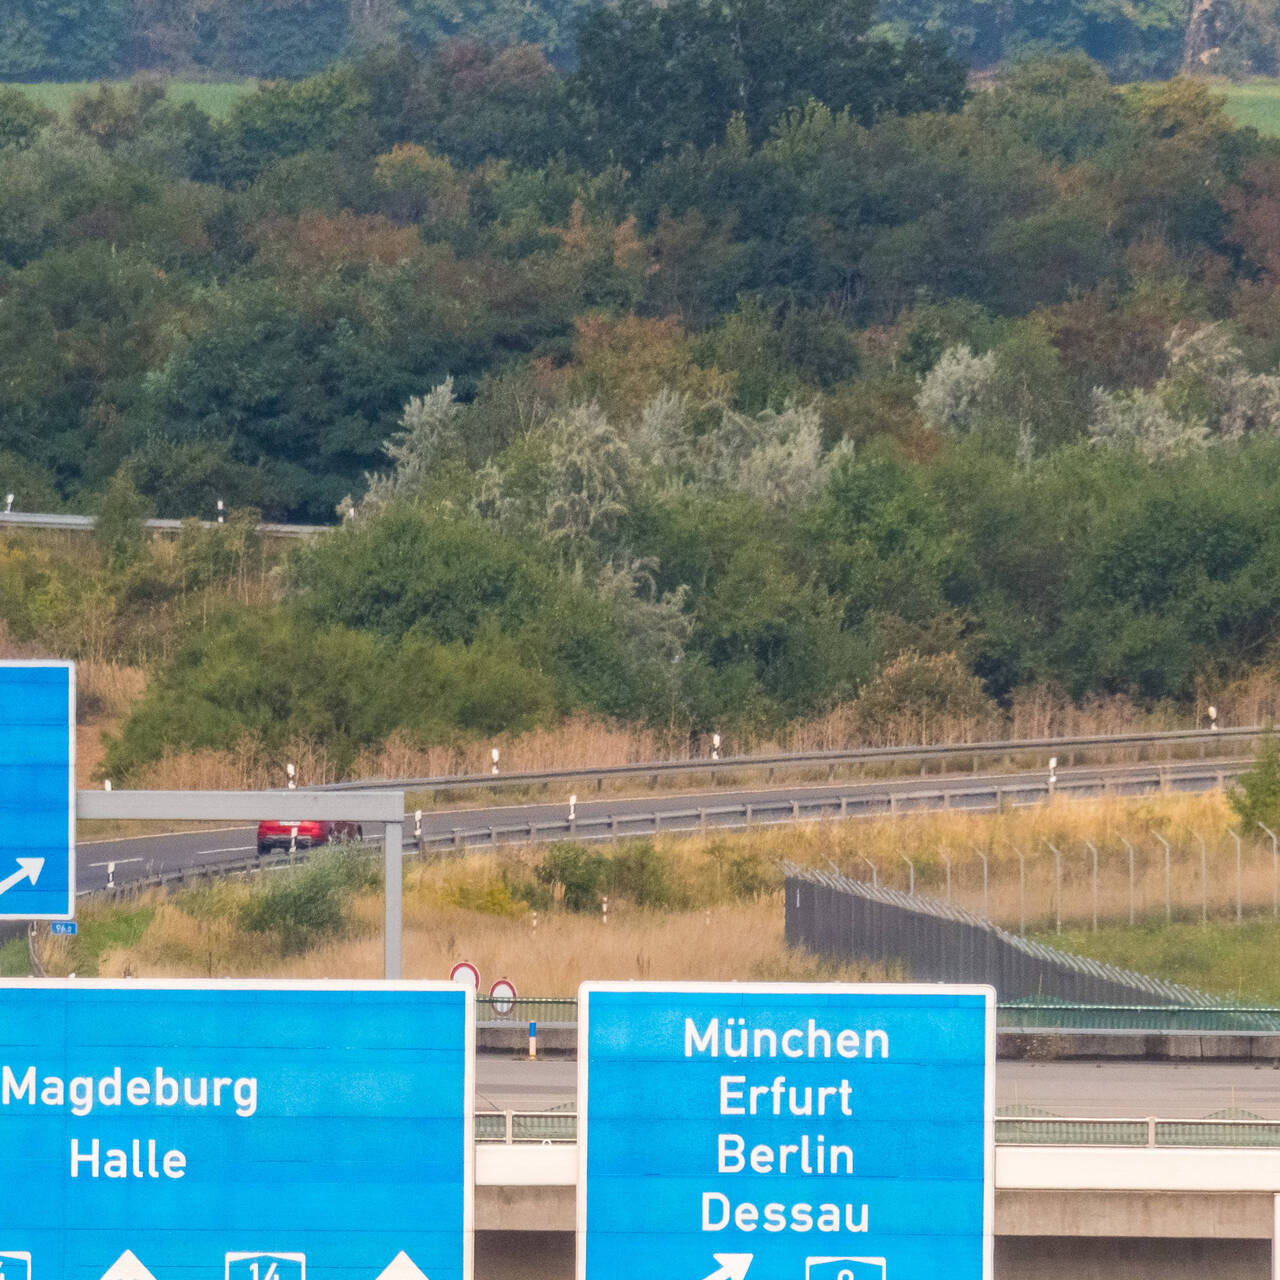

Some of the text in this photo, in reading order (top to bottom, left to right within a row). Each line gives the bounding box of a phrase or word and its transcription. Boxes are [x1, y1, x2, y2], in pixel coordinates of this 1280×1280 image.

[684, 1017, 889, 1059] München
[1, 1065, 258, 1118] Magdeburg
[719, 1075, 853, 1116] Erfurt
[70, 1138, 187, 1179] Halle
[717, 1133, 854, 1174] Berlin
[701, 1191, 869, 1233] Dessau
